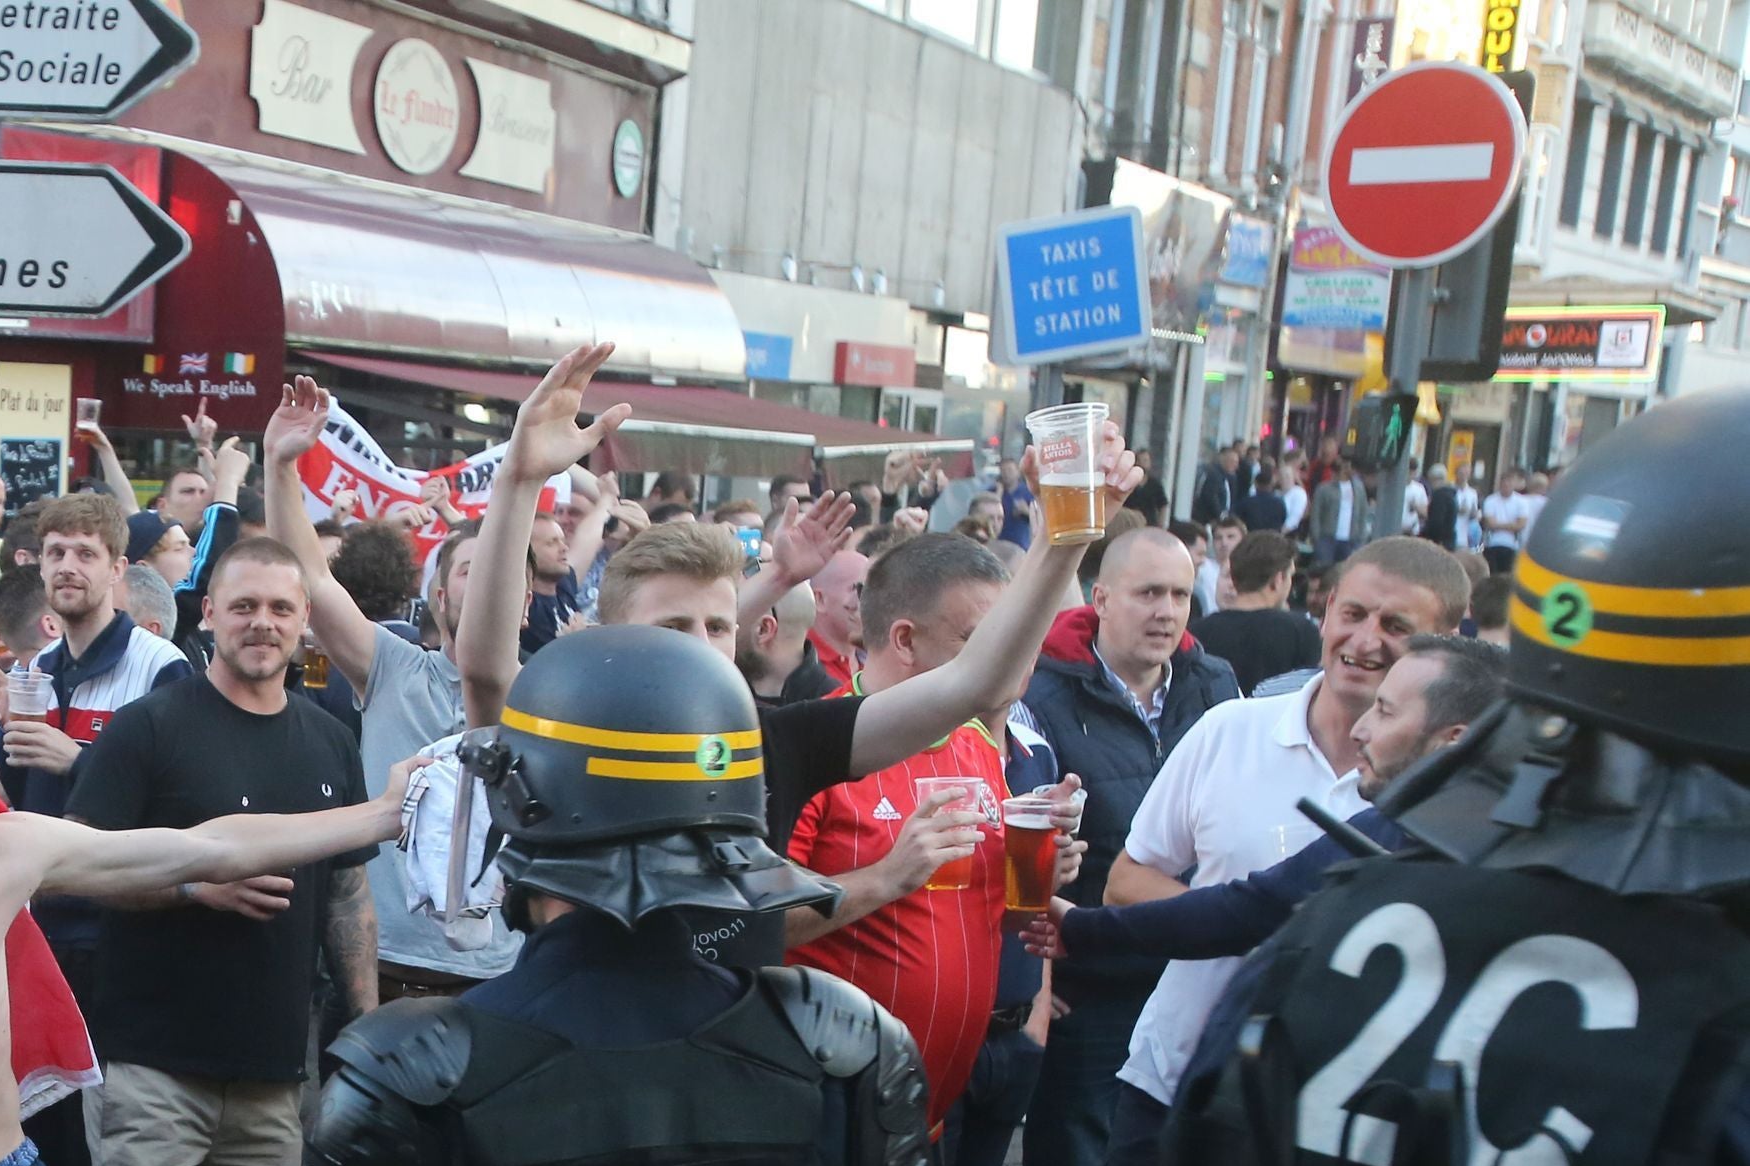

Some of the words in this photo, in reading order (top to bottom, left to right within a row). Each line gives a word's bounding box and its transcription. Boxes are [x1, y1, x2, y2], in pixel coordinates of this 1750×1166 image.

[270, 35, 333, 104] Bar
[1040, 236, 1101, 266] TAXIS
[1029, 275, 1080, 302] TÊTE
[1091, 268, 1119, 292] DE
[1034, 303, 1121, 336] STATION
[0, 388, 21, 412] Plat
[26, 389, 39, 412] du
[42, 392, 65, 420] jour
[123, 378, 146, 393] We
[150, 379, 194, 398] Speak
[199, 380, 257, 400] English
[1043, 441, 1072, 452] STELLA
[1552, 592, 1580, 639] 2
[705, 741, 725, 771] 2
